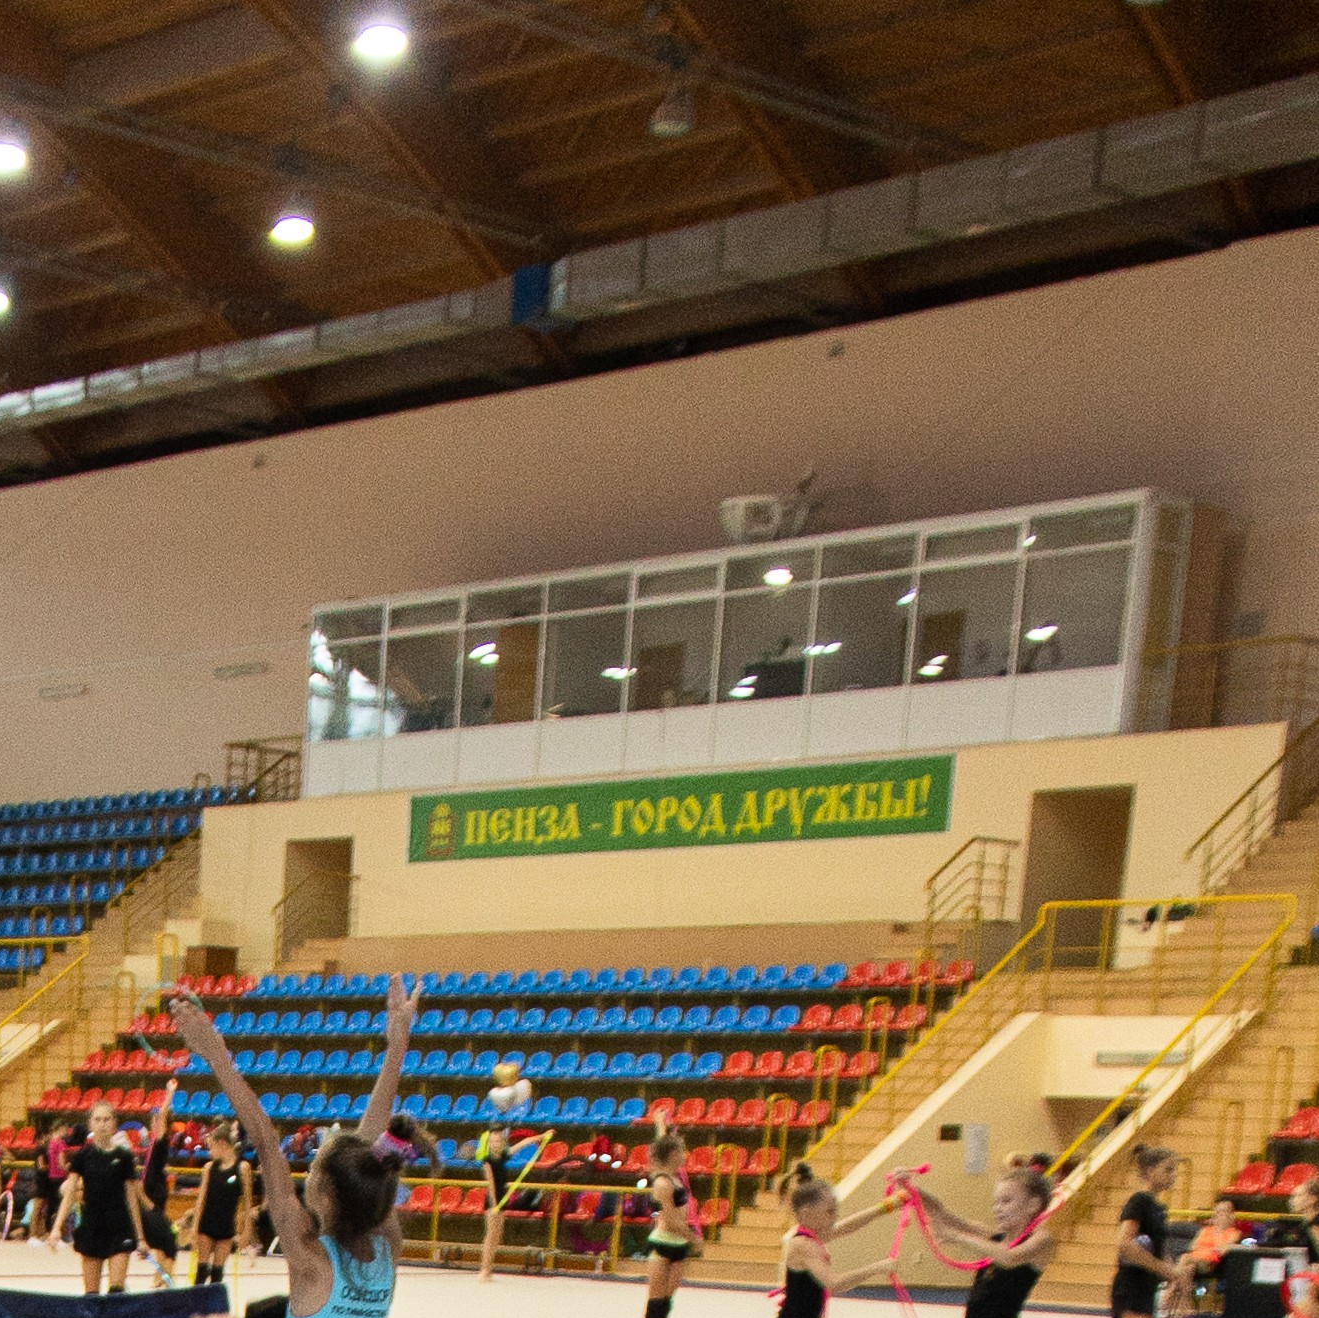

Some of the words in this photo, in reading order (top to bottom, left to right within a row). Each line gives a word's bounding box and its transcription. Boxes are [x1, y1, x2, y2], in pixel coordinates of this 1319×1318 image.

[463, 802, 580, 848] ПЕНЗА
[611, 792, 726, 838] ГОРОД
[732, 773, 933, 836] ДРУЖБЫ!
